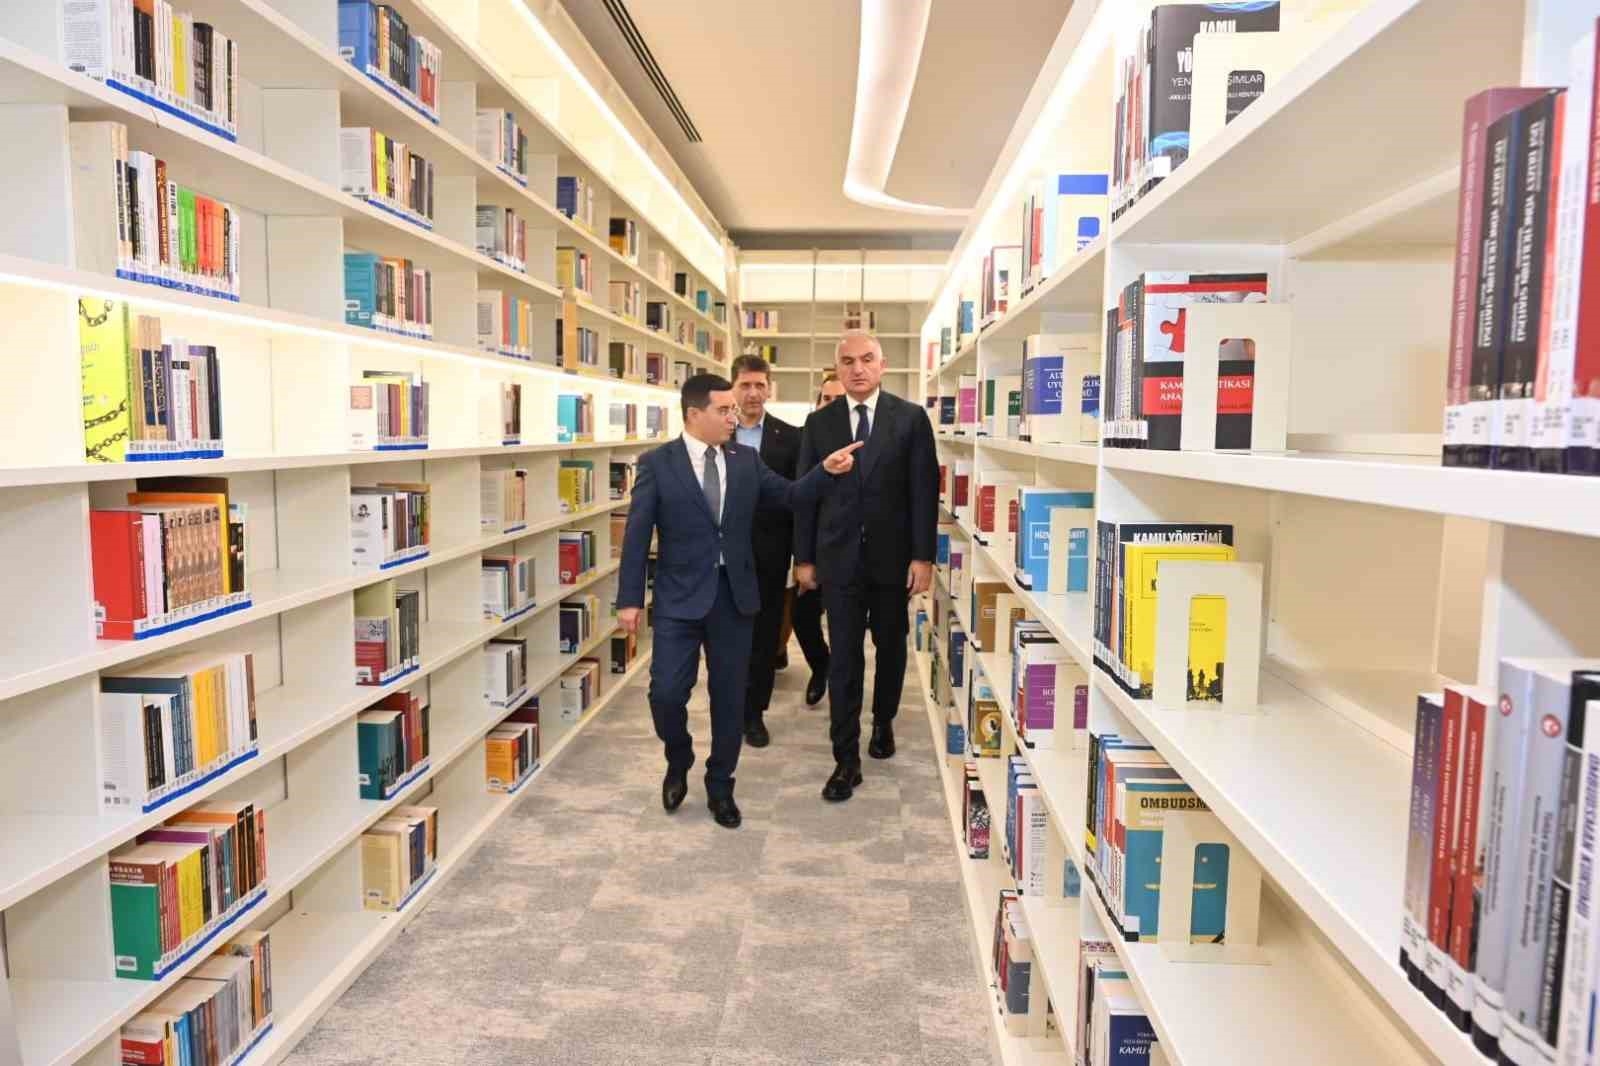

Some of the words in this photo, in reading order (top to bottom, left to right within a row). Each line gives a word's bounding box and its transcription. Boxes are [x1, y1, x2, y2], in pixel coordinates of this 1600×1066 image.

[1172, 77, 1192, 87] YEN
[1160, 380, 1184, 390] KAM
[1133, 531, 1165, 545] KAMU
[1140, 797, 1207, 809] OMBUDSM
[1119, 1046, 1147, 1055] KAMU
